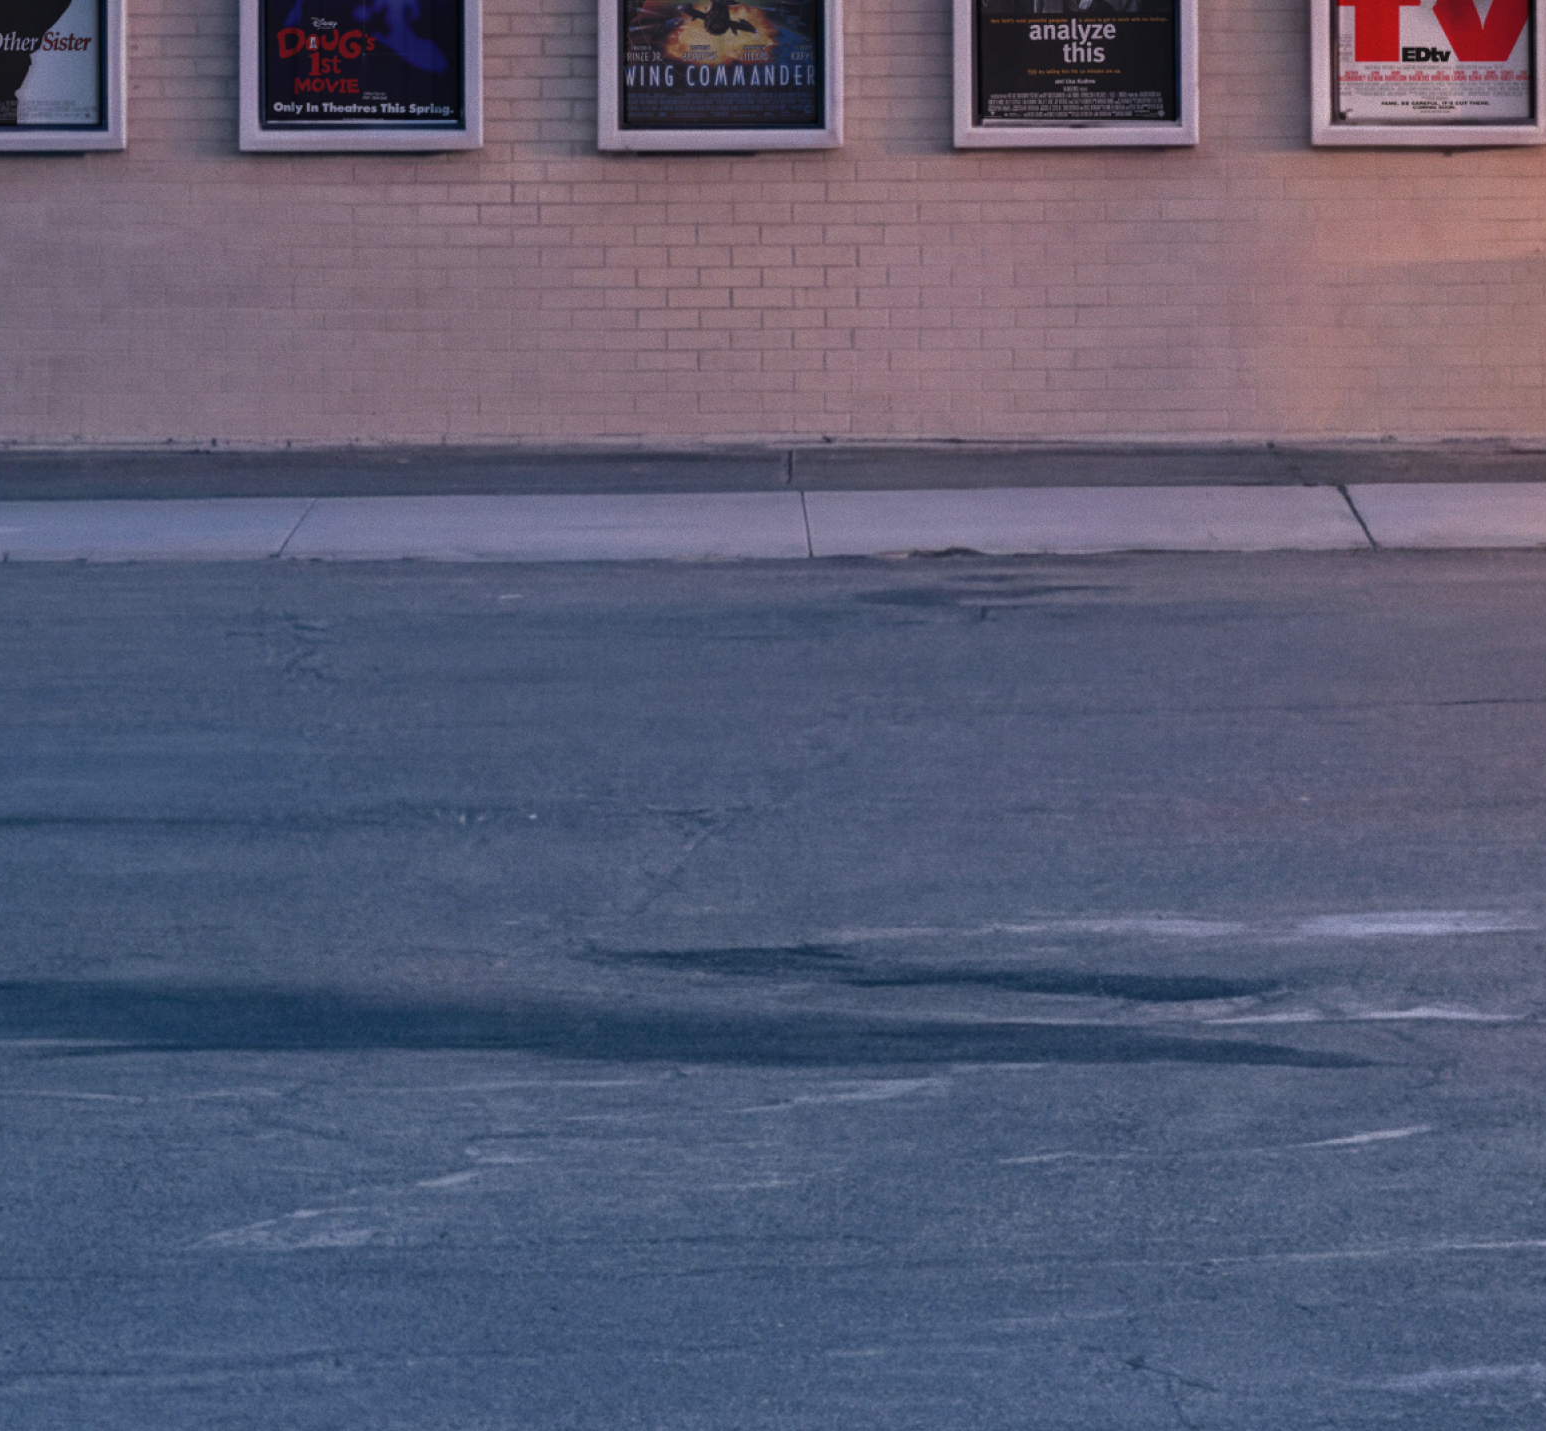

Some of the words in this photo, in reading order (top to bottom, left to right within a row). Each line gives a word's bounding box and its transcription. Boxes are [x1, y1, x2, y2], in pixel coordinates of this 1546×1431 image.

[42, 31, 92, 52] Sister
[1028, 17, 1116, 45] analyze
[626, 51, 650, 62] RINZE
[1062, 41, 1106, 63] this
[1401, 46, 1452, 63] EDtv
[308, 52, 342, 76] 1st
[294, 77, 360, 95] MOVIE
[625, 64, 674, 87] WING
[685, 64, 816, 87] COMMANDER
[273, 101, 303, 116] Only
[306, 102, 319, 113] In
[321, 101, 377, 114] Theatres
[380, 101, 406, 114] This
[408, 101, 455, 117] Spring.
